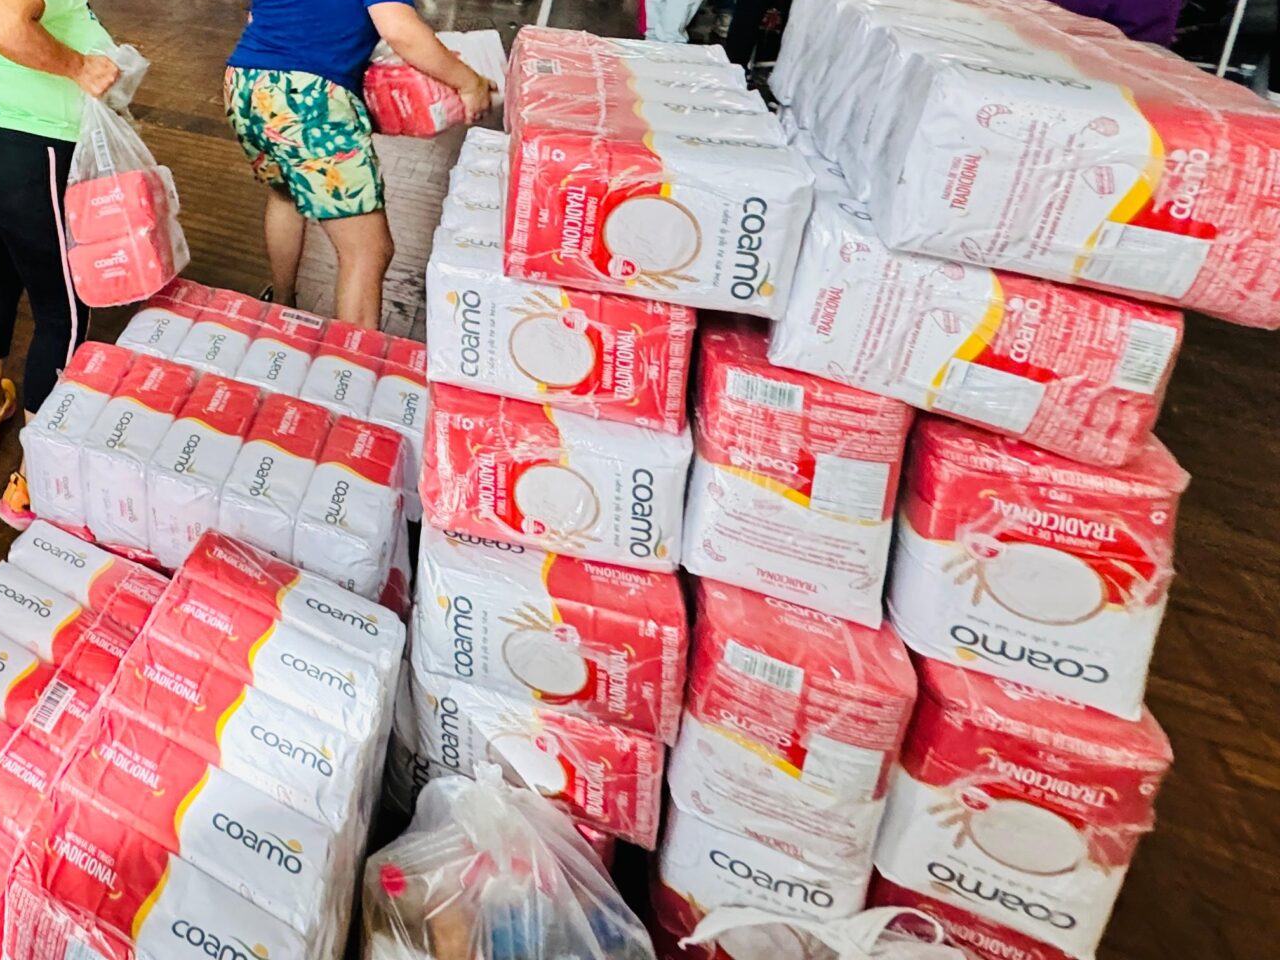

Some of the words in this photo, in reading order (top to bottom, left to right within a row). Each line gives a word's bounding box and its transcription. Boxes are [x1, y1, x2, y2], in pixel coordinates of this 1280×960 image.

[949, 153, 982, 211] TRADICIONAL
[1167, 148, 1210, 219] coamo
[560, 186, 585, 259] TRADICIONAL
[583, 226, 594, 235] DE
[730, 196, 768, 301] coamo
[459, 290, 481, 377] coamo
[816, 286, 844, 337] TRADICIONAL
[604, 354, 614, 362] DE
[614, 329, 635, 399] TRADICIONAL
[334, 369, 352, 400] coamo
[47, 393, 75, 432] coamo
[106, 411, 133, 449] coamo
[174, 434, 201, 474] coamo
[249, 456, 274, 497] coamo
[325, 480, 350, 525] coamo
[629, 468, 654, 558] coamo
[988, 497, 1117, 543] TRADICIONAL
[33, 538, 86, 569] coamo
[211, 546, 263, 580] TRADICIONAL
[583, 562, 654, 587] TRADICIONAL
[754, 566, 819, 593] TRADICIONAL
[180, 603, 238, 636] TRADICIONAL
[306, 598, 379, 637] coamo
[454, 595, 473, 678] coamo
[280, 653, 357, 699] coamo
[949, 624, 1109, 685] coamo
[143, 665, 202, 704] TRADICIONAL
[607, 650, 629, 713] TRADICIONAL
[250, 724, 334, 777] coamo
[442, 696, 459, 770] coamo
[100, 744, 161, 789] TRADICIONAL
[988, 755, 1108, 807] TRADICIONAL
[52, 836, 118, 889] TRADICIONAL
[212, 813, 303, 875] coamo
[708, 849, 834, 908] coamo
[927, 862, 1077, 930] coamo
